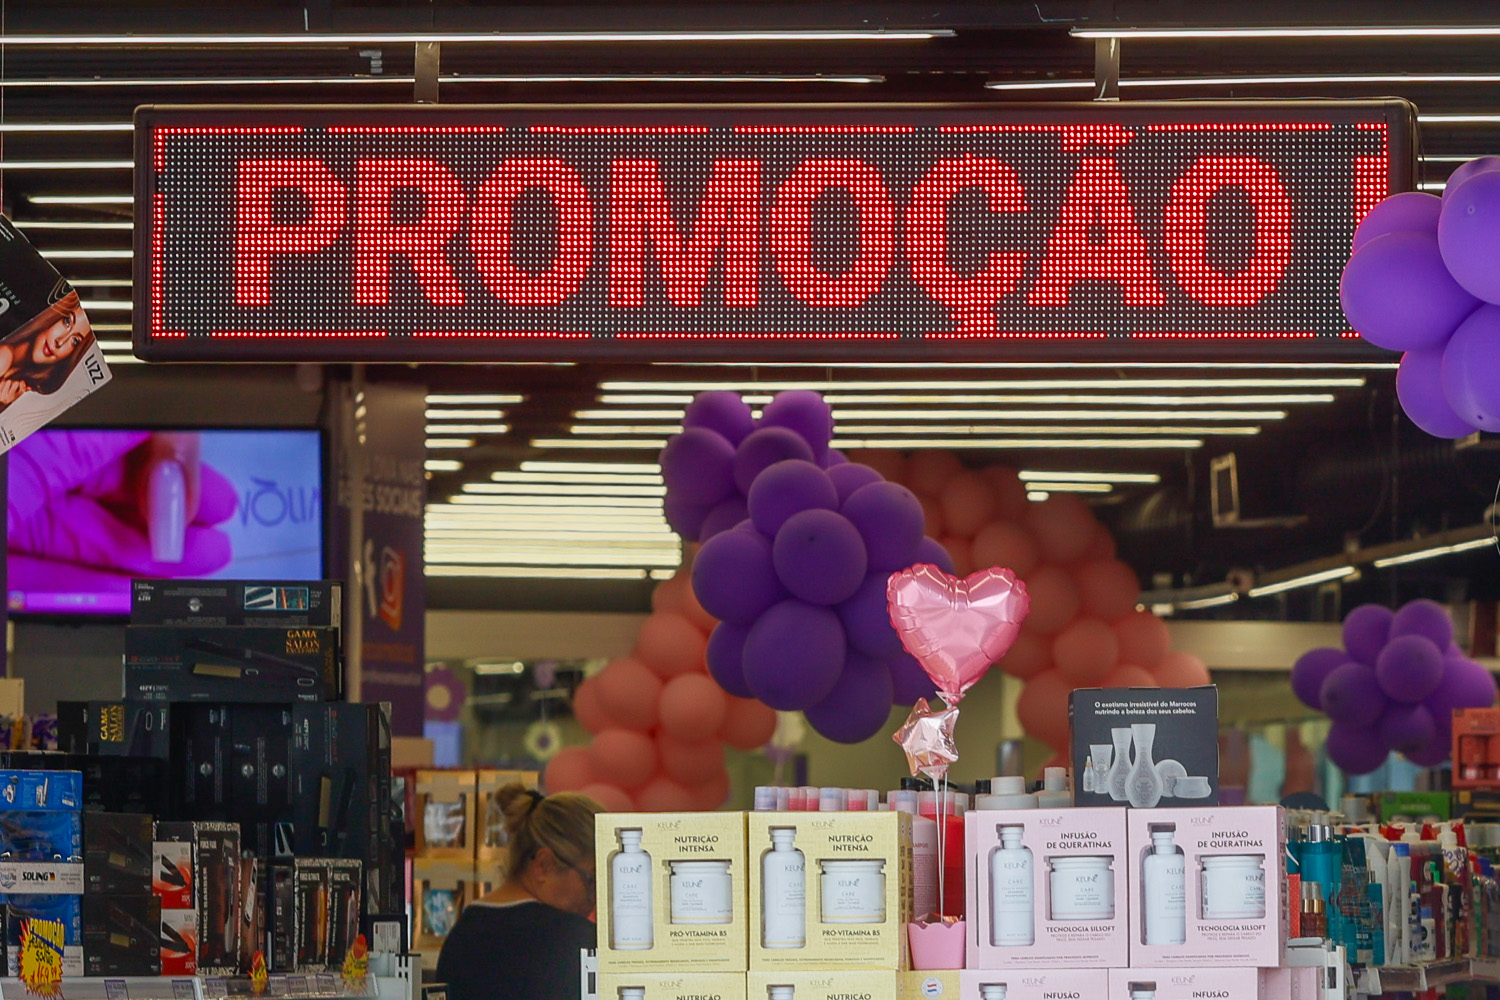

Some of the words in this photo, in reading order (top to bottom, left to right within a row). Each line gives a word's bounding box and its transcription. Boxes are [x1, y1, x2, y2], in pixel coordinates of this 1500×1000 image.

[235, 125, 1292, 337] PROMOÇÃO
[84, 354, 104, 384] LIZZ
[287, 630, 317, 638] GAMA
[286, 640, 320, 648] SALON
[100, 707, 108, 740] GAMA
[110, 706, 118, 742] SALON
[674, 835, 718, 844] NUTRIÇÃO
[828, 835, 873, 843] NUTRIÇÃO
[1058, 841, 1111, 849] QUERATINAS
[1210, 840, 1263, 848] QUERATINAS
[619, 864, 642, 873] KEUNE
[22, 872, 48, 881] SOLING
[1076, 874, 1098, 882] KEUNE
[838, 879, 860, 887] KEUNE
[1043, 991, 1080, 1000] INFUSÃO
[1192, 990, 1229, 998] INFUSÃO
